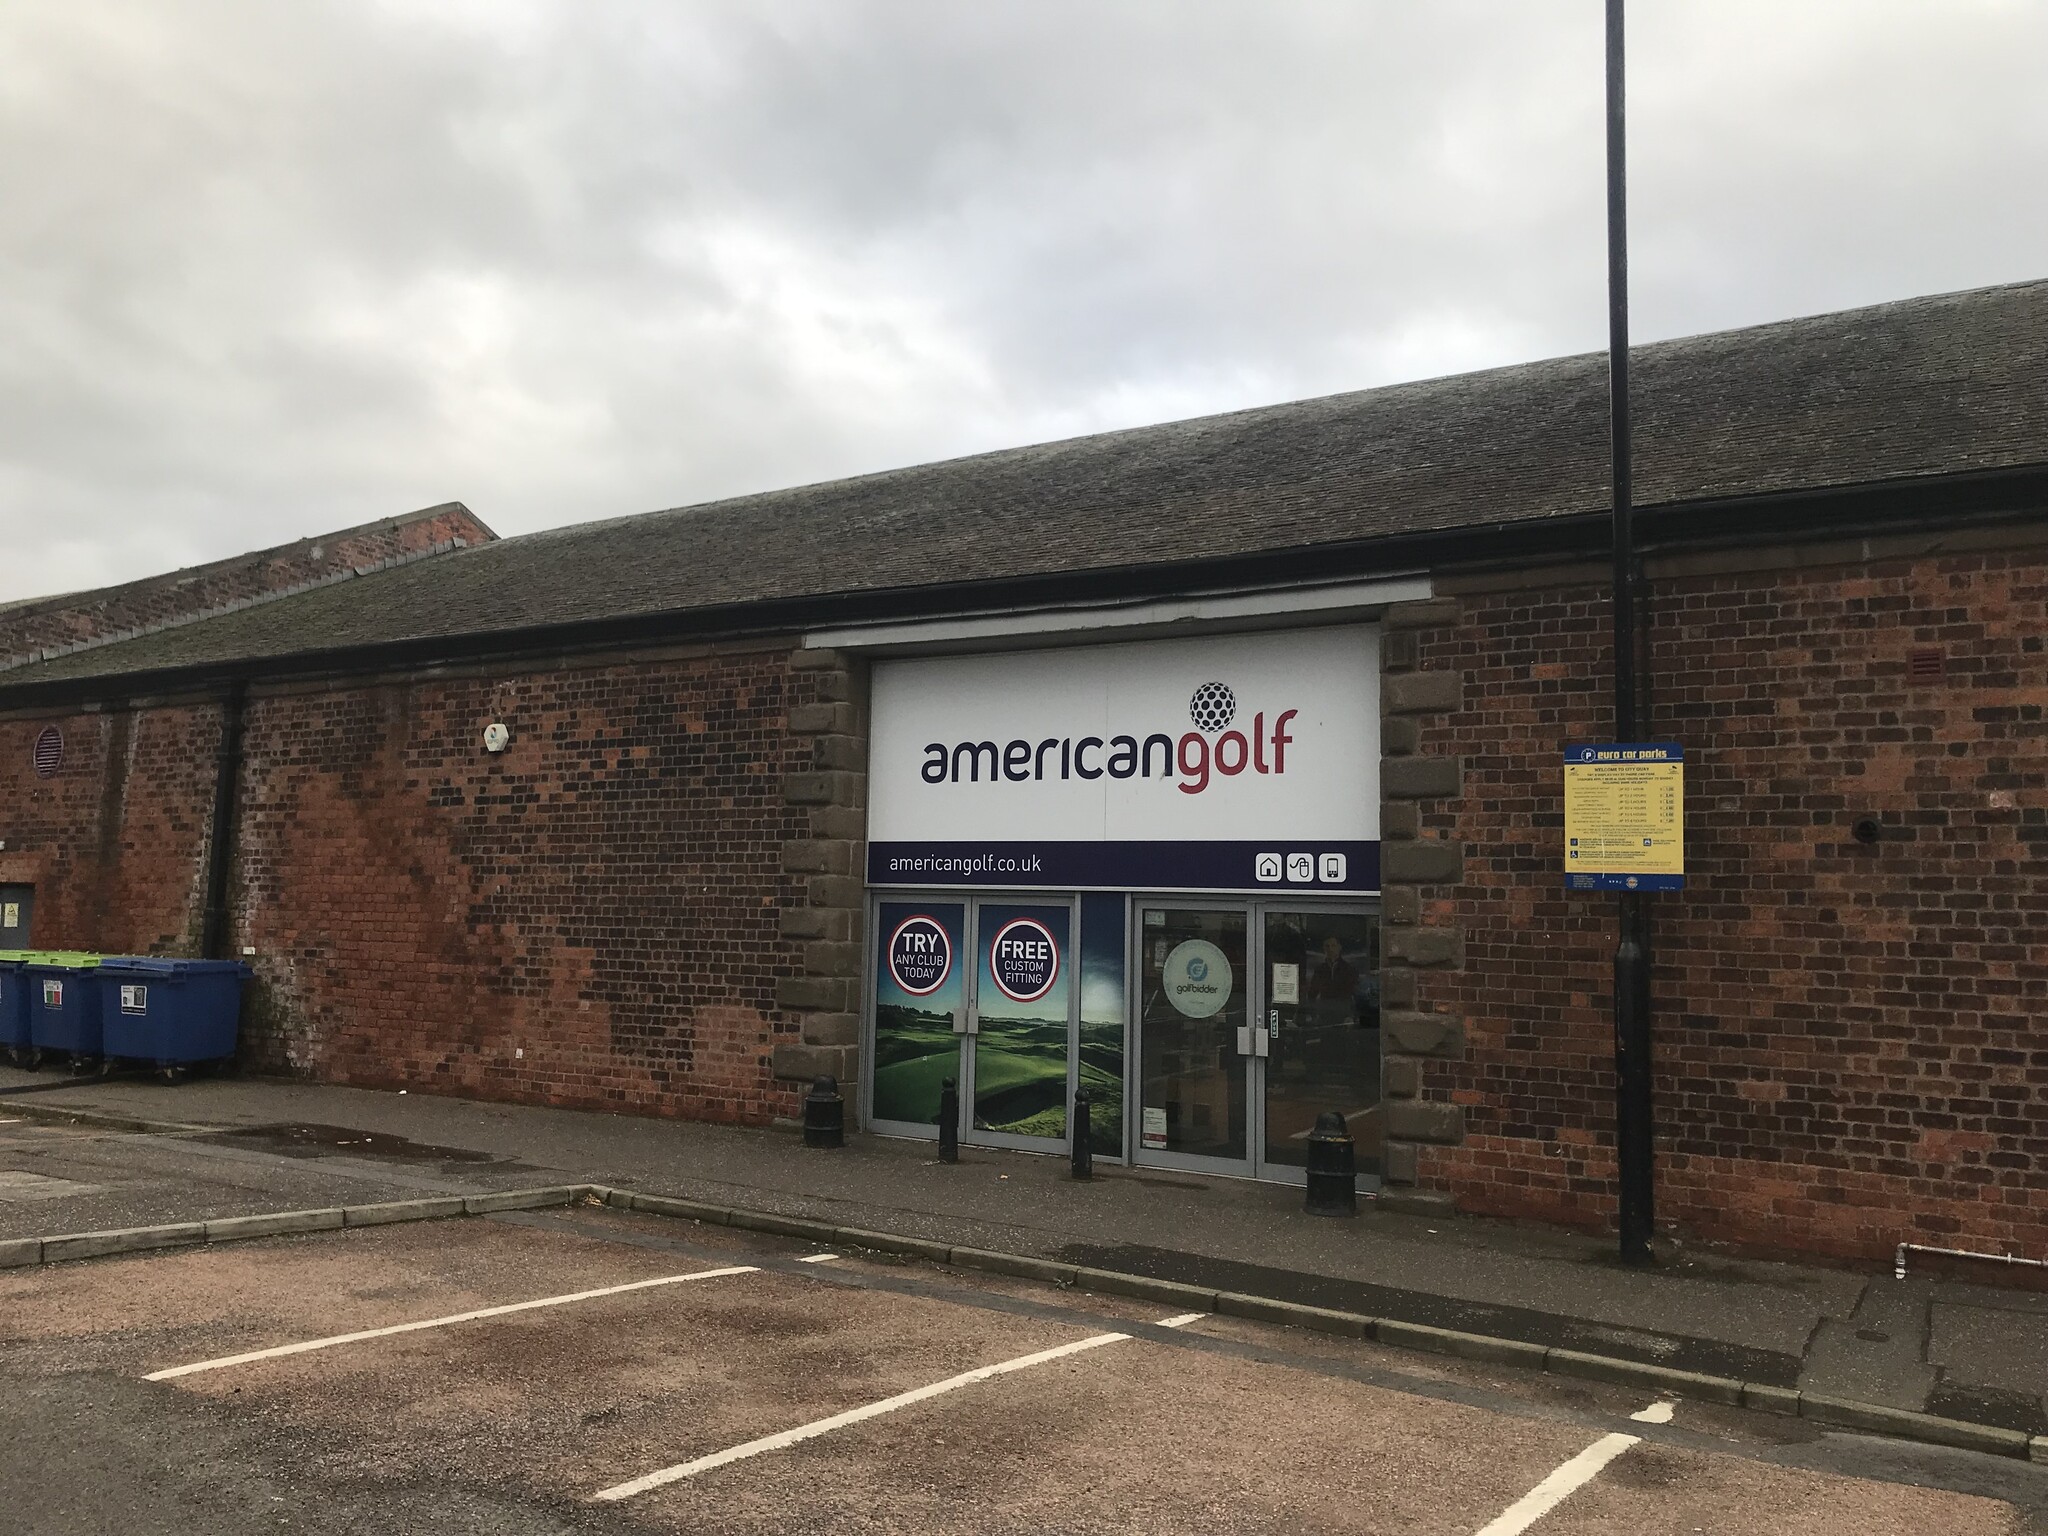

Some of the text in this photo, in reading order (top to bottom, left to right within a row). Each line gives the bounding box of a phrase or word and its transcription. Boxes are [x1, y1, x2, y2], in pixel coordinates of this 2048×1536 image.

[921, 709, 1299, 794] americangolf
[1597, 751, 1620, 760] euro
[1622, 750, 1637, 760] car
[1639, 748, 1667, 760] parks
[889, 853, 1042, 876] americangolf.co.uk
[902, 933, 939, 953] TRY
[1001, 940, 1048, 960] FREE
[895, 954, 944, 967] ANY CLUB
[1004, 960, 1044, 972] CUSTOM
[904, 966, 935, 979] TODAY
[1005, 972, 1043, 984] FITTING
[1176, 983, 1218, 995] golfbidder
